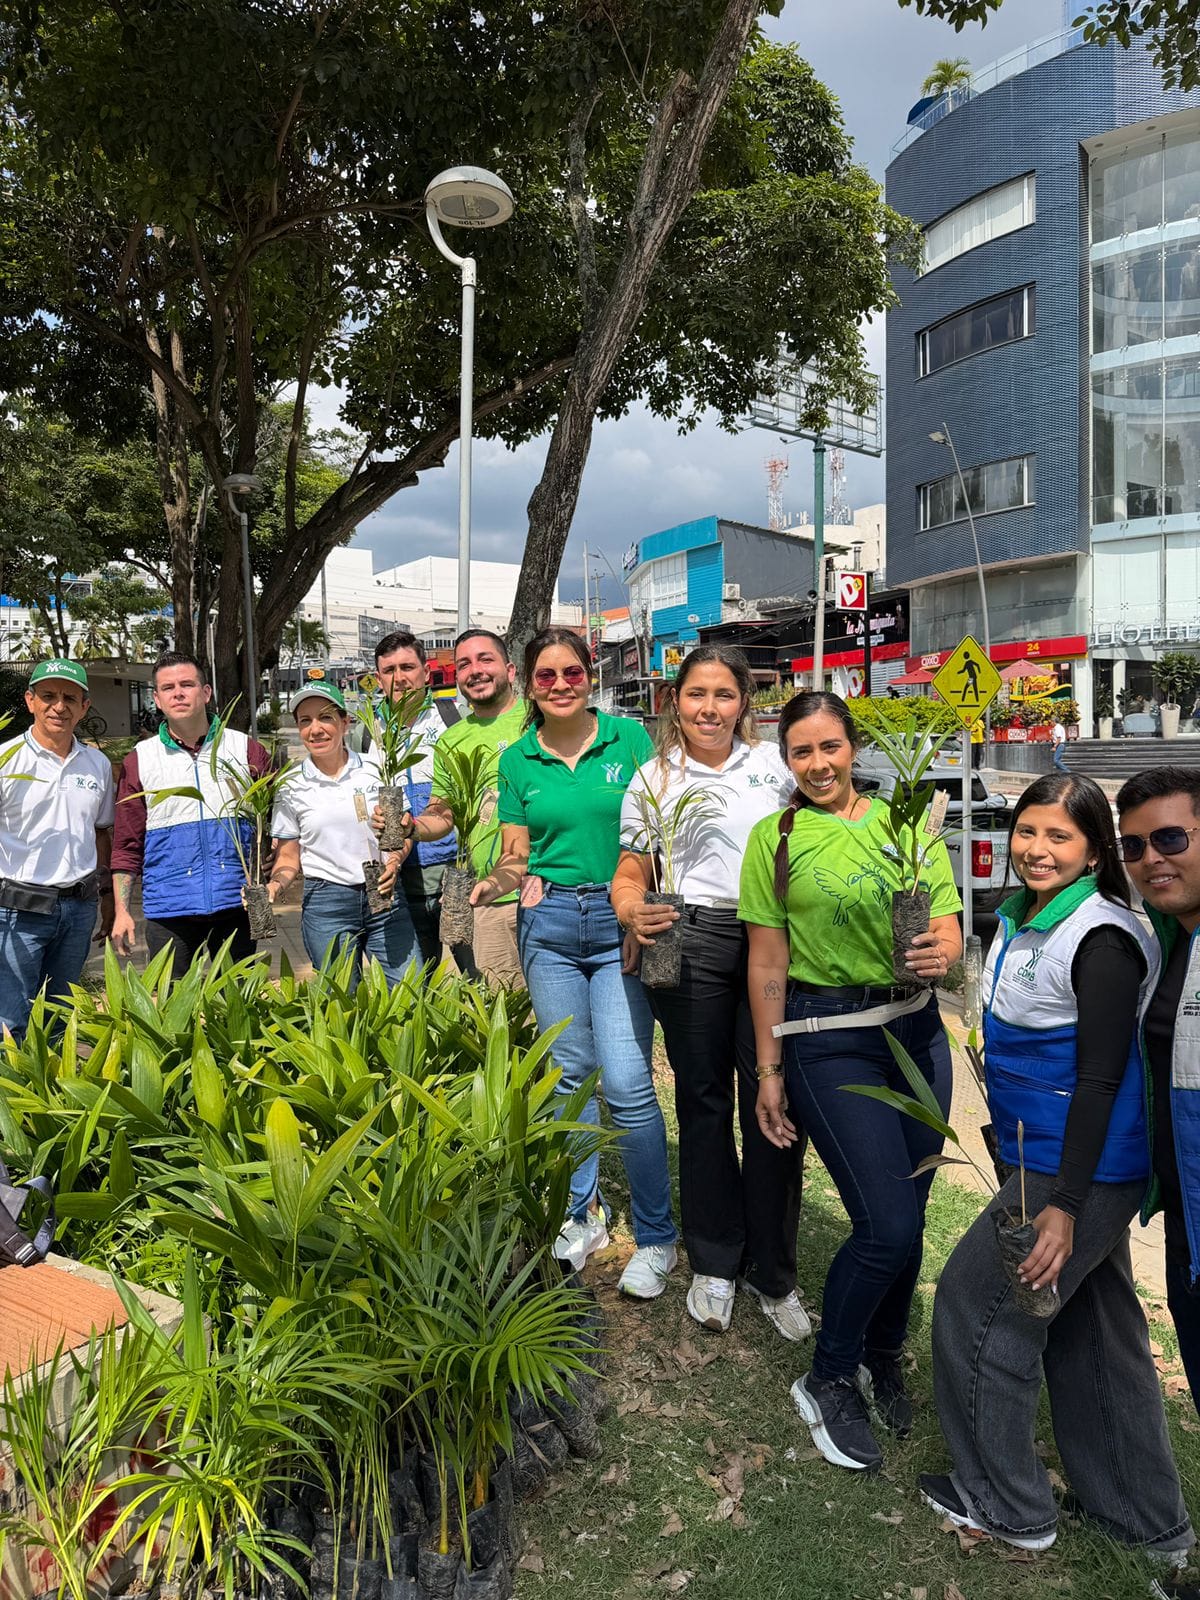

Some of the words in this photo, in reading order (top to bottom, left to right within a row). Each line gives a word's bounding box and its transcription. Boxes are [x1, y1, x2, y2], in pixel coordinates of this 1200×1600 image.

[1094, 622, 1200, 645] HOTEL
[1026, 642, 1040, 651] 24
[921, 655, 940, 667] OXXO
